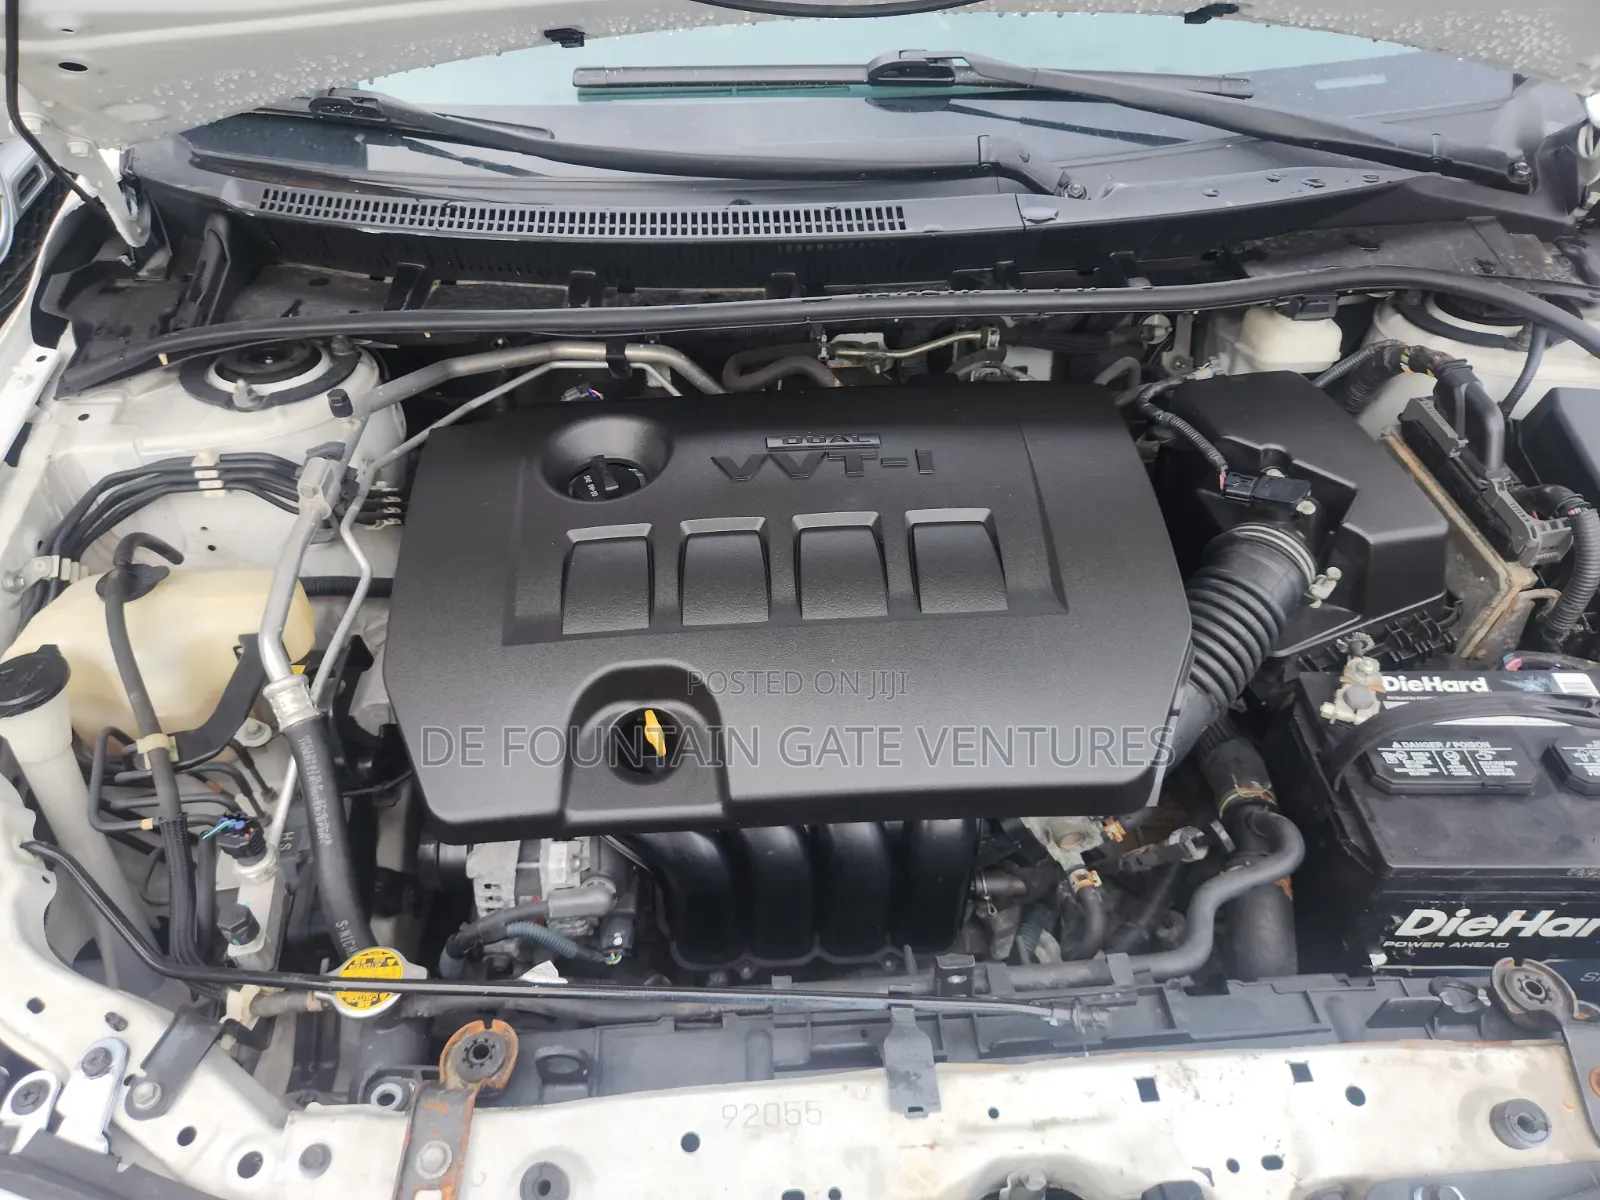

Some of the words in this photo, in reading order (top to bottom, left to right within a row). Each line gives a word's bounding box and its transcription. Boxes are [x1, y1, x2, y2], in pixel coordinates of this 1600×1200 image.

[781, 434, 871, 445] DUAL
[1381, 675, 1490, 693] DieHard
[1401, 741, 1445, 749] DANGER
[1452, 741, 1492, 749] POISON
[1394, 908, 1600, 938] DieHar
[1382, 940, 1445, 949] POWER
[1448, 940, 1511, 949] AHEAD
[721, 1100, 822, 1129] 92055
